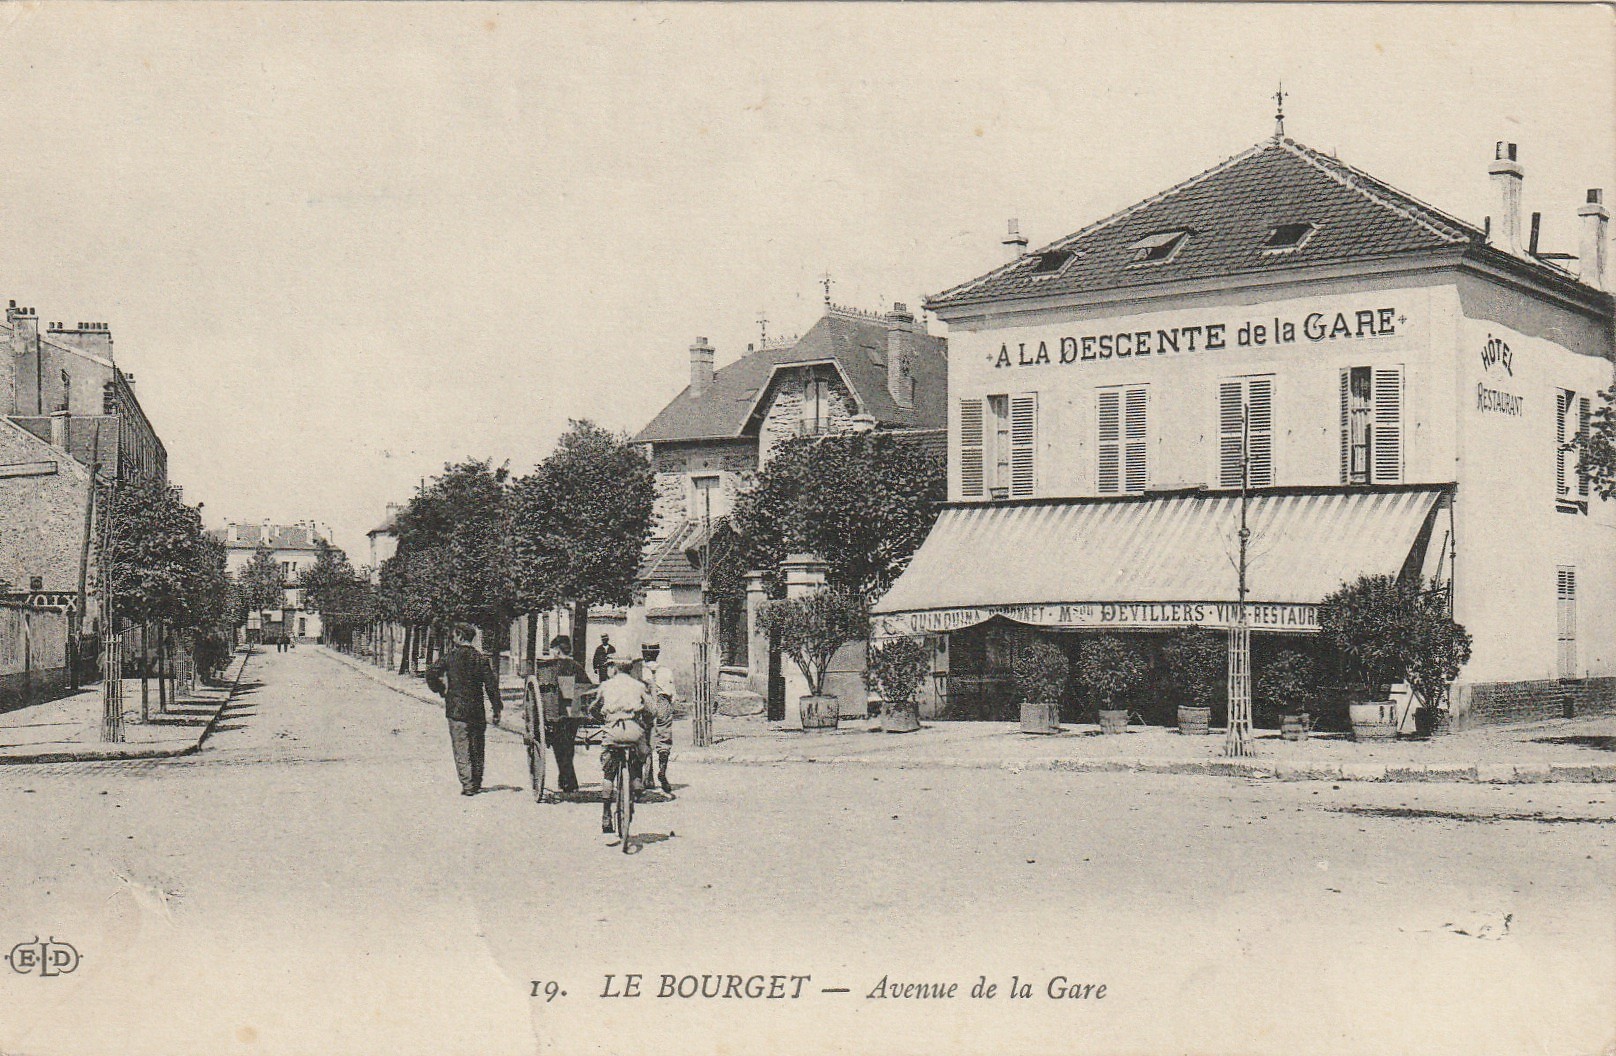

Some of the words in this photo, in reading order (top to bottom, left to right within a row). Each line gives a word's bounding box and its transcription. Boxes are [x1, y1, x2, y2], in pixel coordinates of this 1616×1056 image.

[1018, 341, 1051, 367] LA
[1058, 322, 1227, 365] DESCENTE
[1238, 320, 1267, 347] de
[1274, 317, 1296, 343] la
[1303, 307, 1398, 341] GARE
[1100, 604, 1205, 623] DEVILLERS
[1254, 605, 1320, 627] RESTAUR
